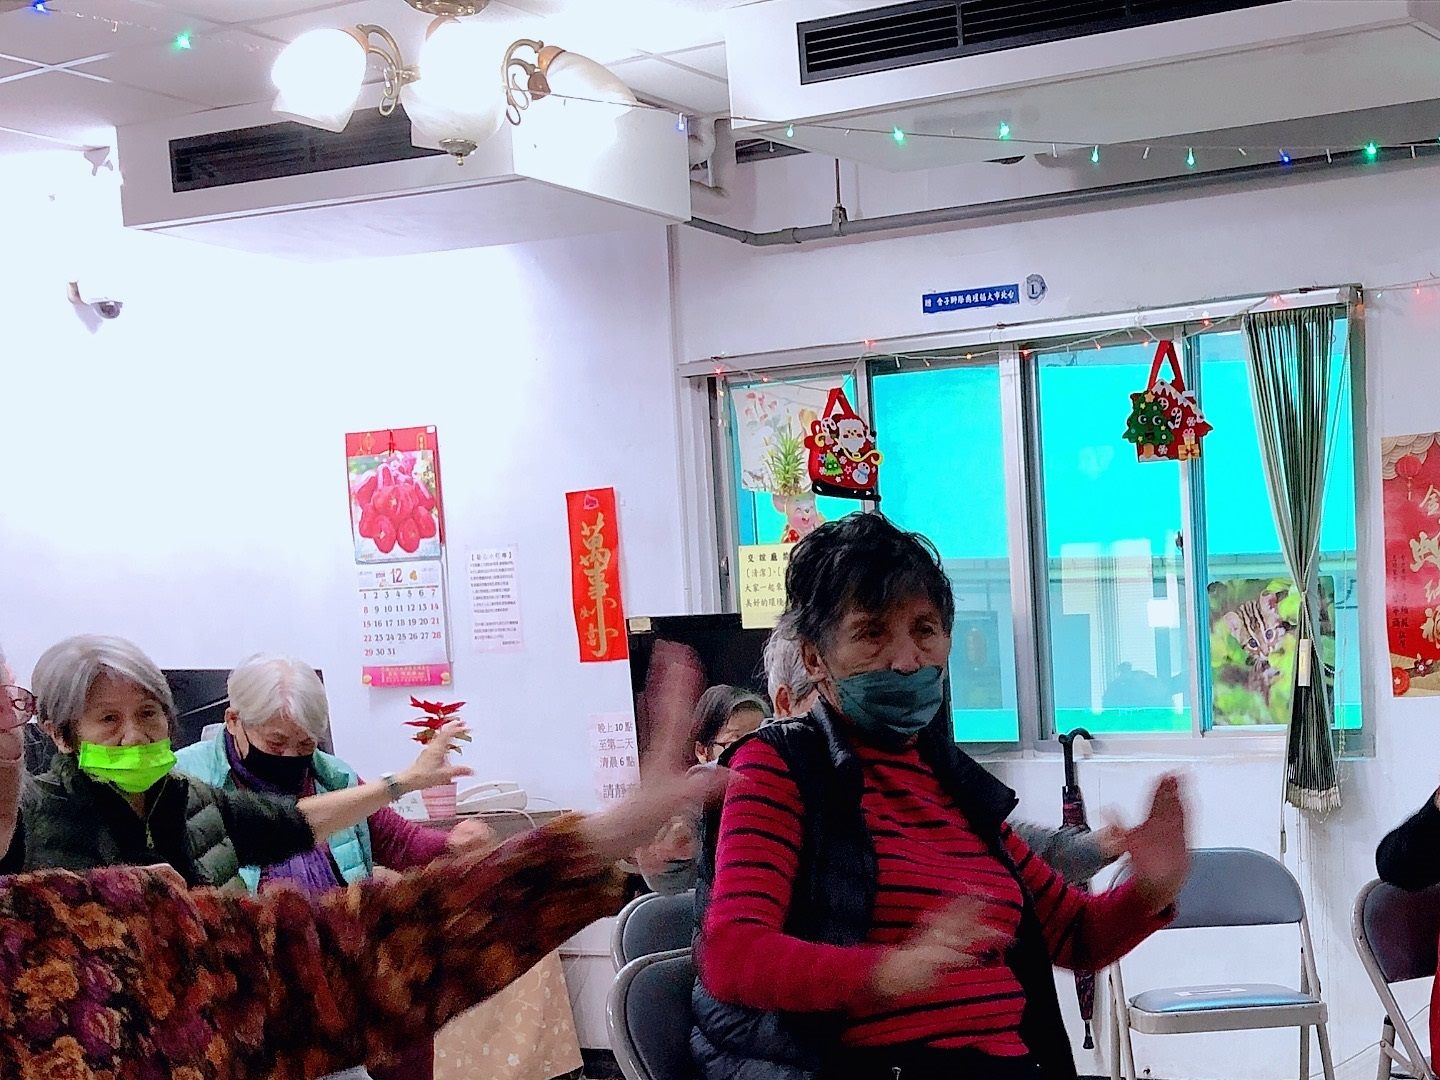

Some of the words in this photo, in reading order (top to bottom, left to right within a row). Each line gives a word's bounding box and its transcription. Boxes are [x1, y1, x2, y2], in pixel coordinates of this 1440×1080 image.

[391, 568, 402, 583] 12
[745, 582, 786, 592] 大家一起來
[599, 738, 633, 750] 至第二天
